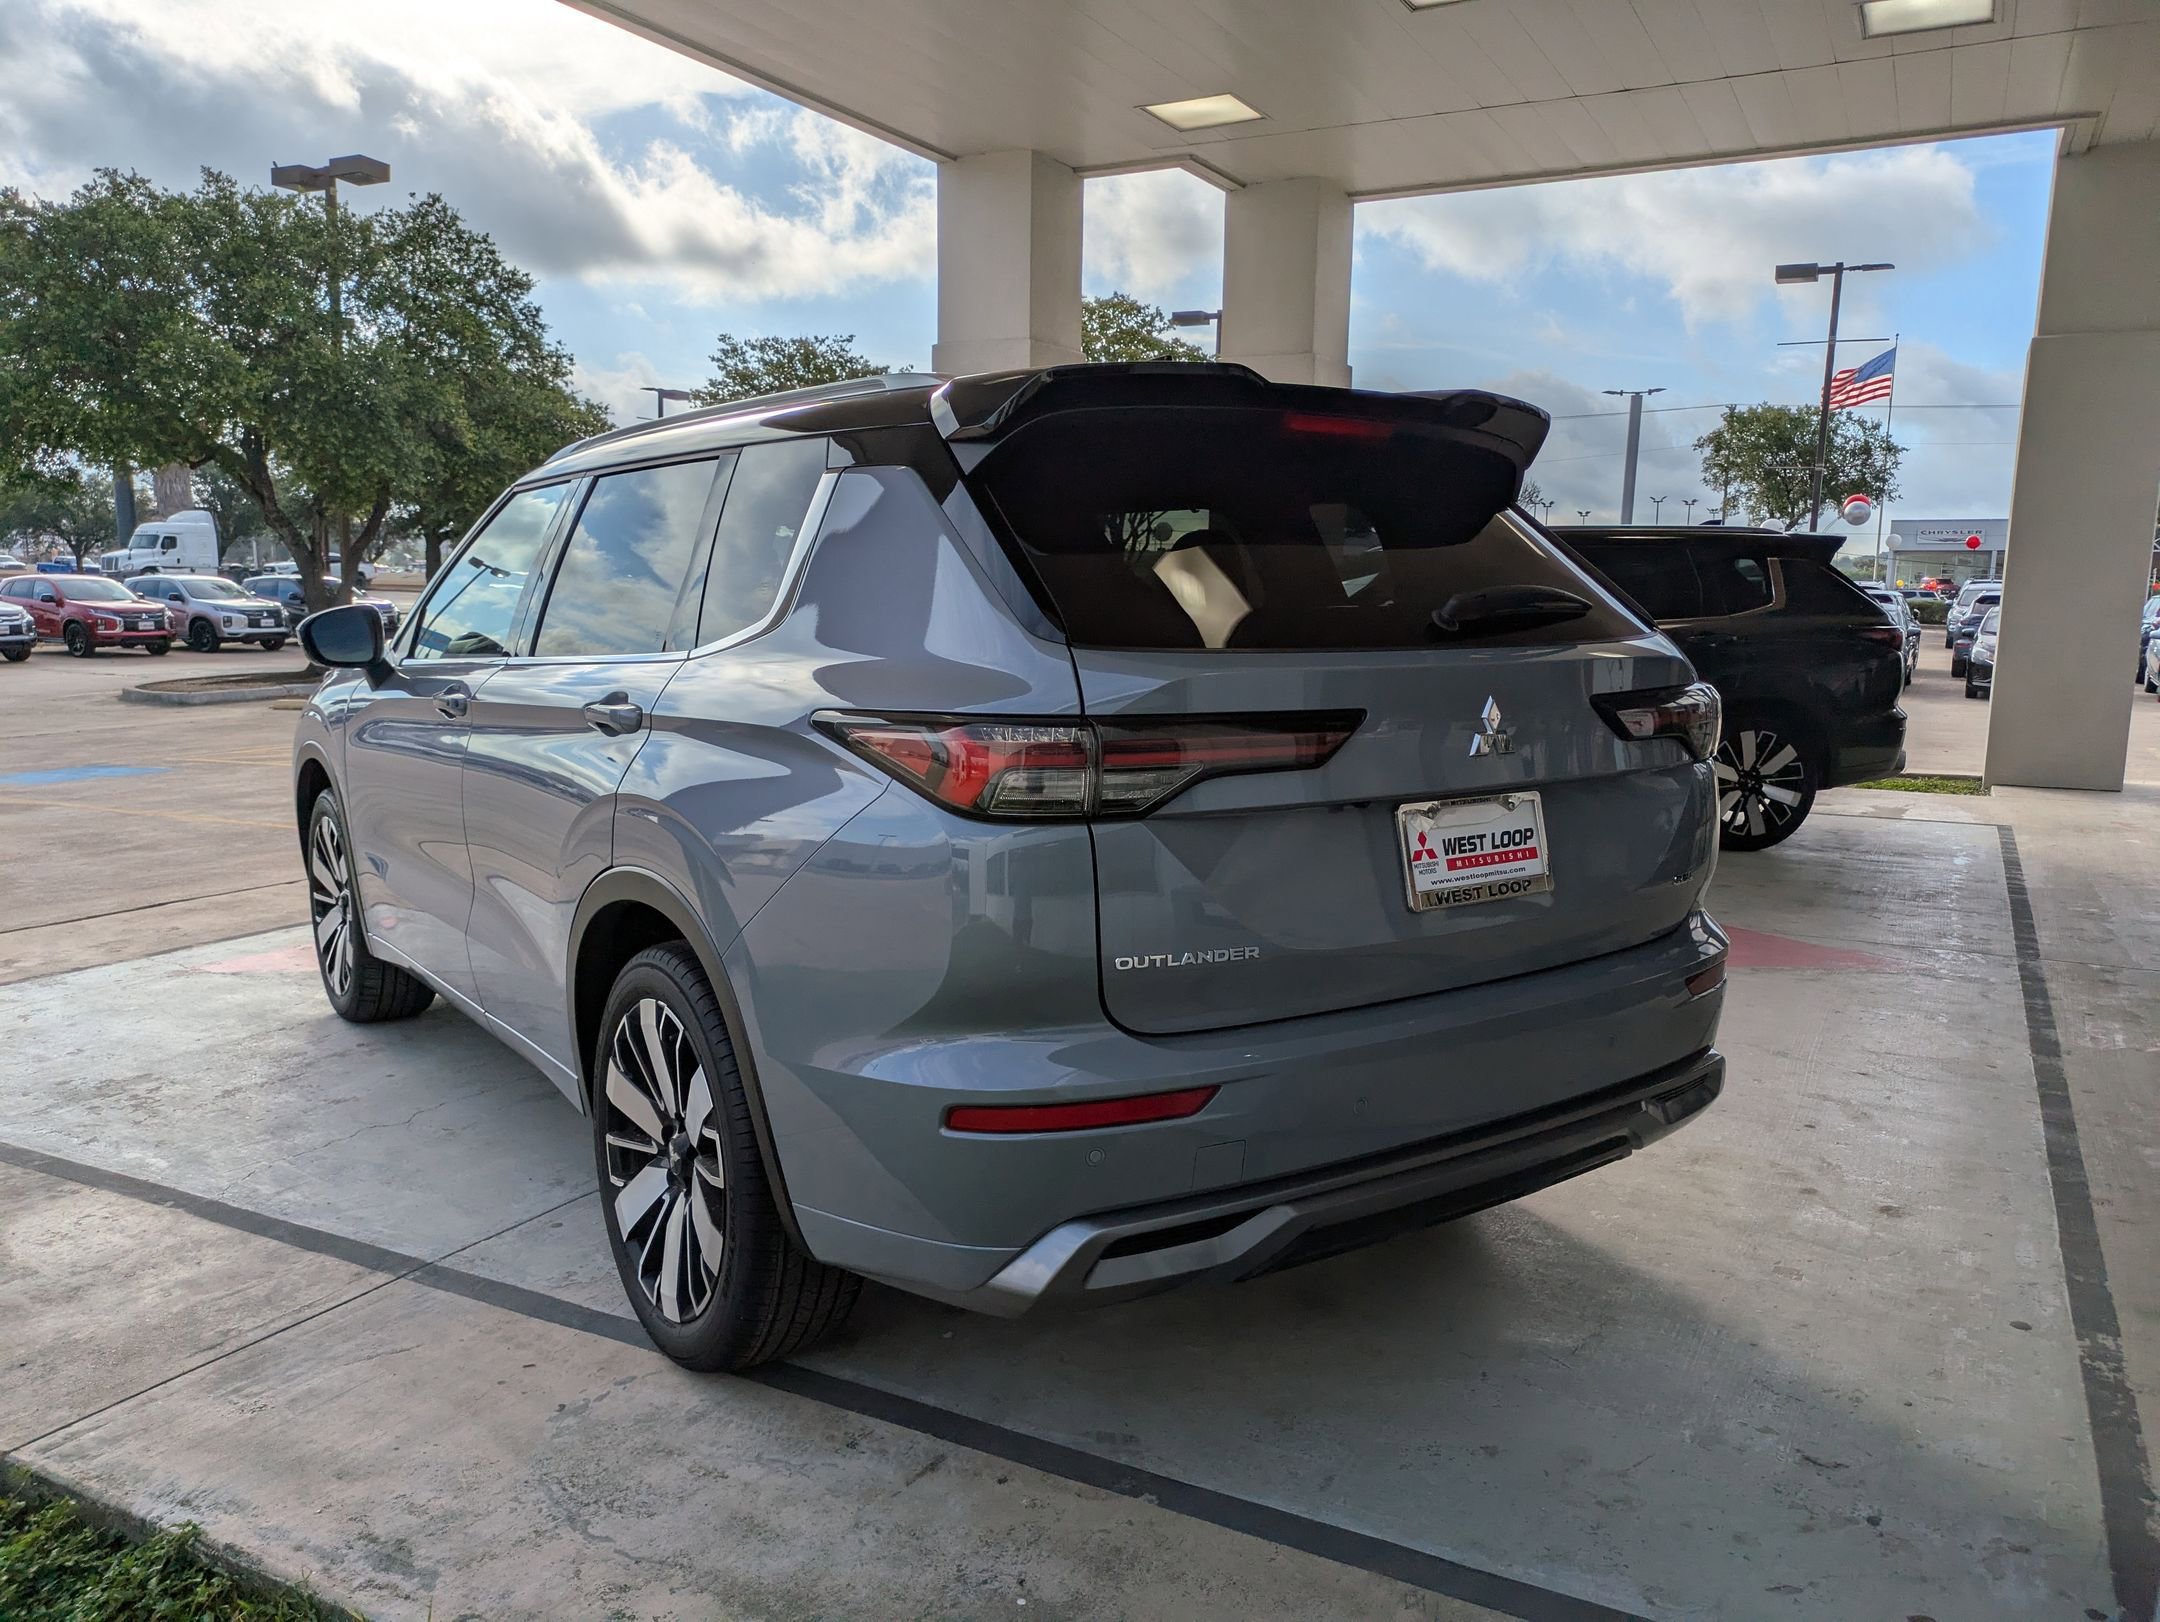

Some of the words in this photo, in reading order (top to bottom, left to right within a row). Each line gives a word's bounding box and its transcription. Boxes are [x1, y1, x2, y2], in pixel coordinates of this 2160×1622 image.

[1442, 834, 1486, 856] WEST
[1492, 828, 1534, 850] LOOP
[1414, 861, 1440, 869] MITSUBISHI
[1456, 851, 1530, 868] MITSUBISHI
[1419, 868, 1437, 876] MOTORS
[1430, 866, 1526, 886] www.westloopmitsu.com
[1436, 887, 1482, 905] WEST
[1489, 880, 1531, 897] LOOP
[1115, 946, 1260, 970] OUTLANDER
